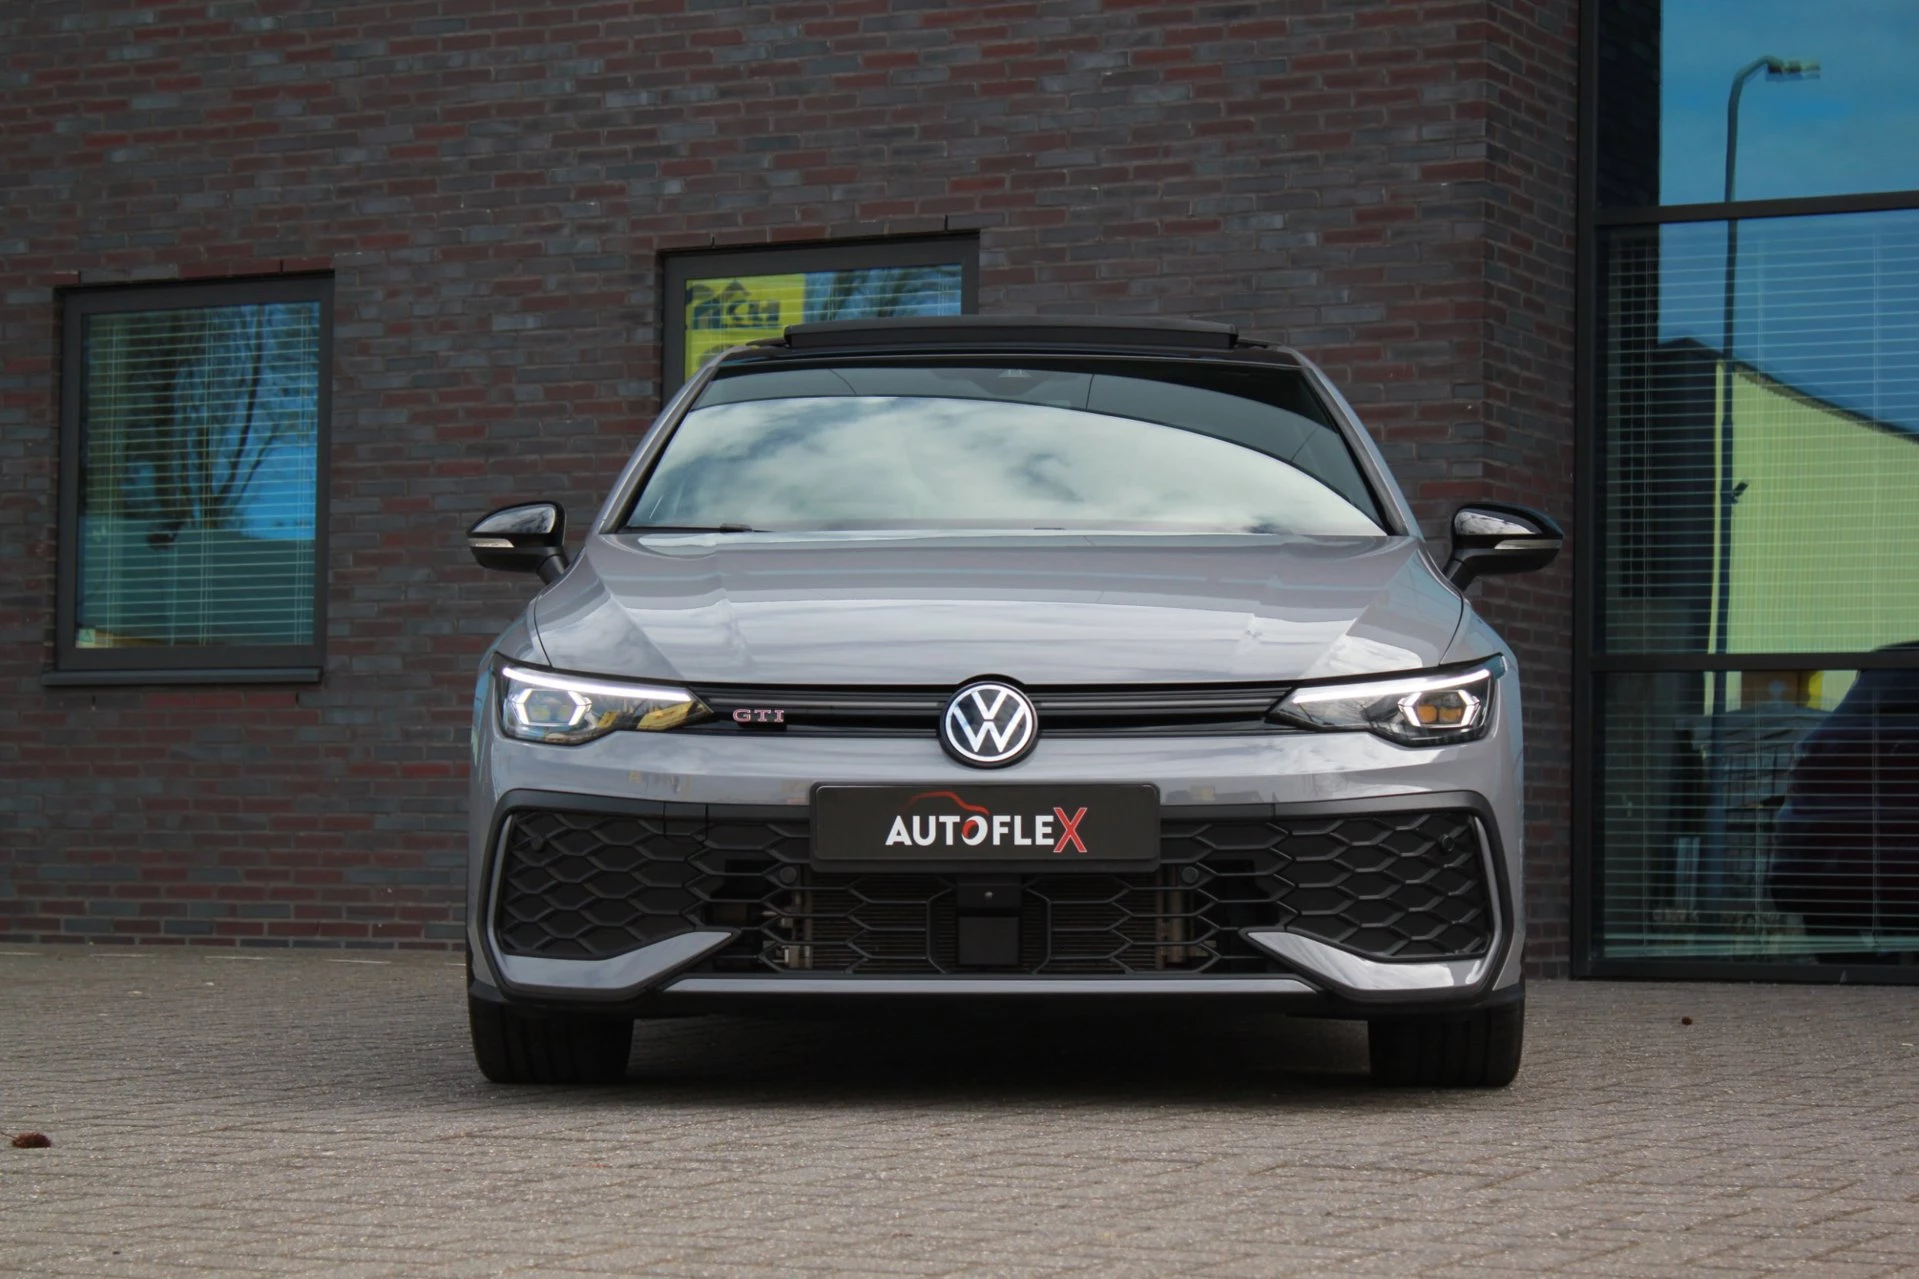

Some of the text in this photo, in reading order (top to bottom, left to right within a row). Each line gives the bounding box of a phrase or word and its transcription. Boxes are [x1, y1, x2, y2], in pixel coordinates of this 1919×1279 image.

[732, 708, 785, 723] GTI
[949, 687, 1030, 757] VW
[885, 806, 1088, 853] AUTOFLEX
